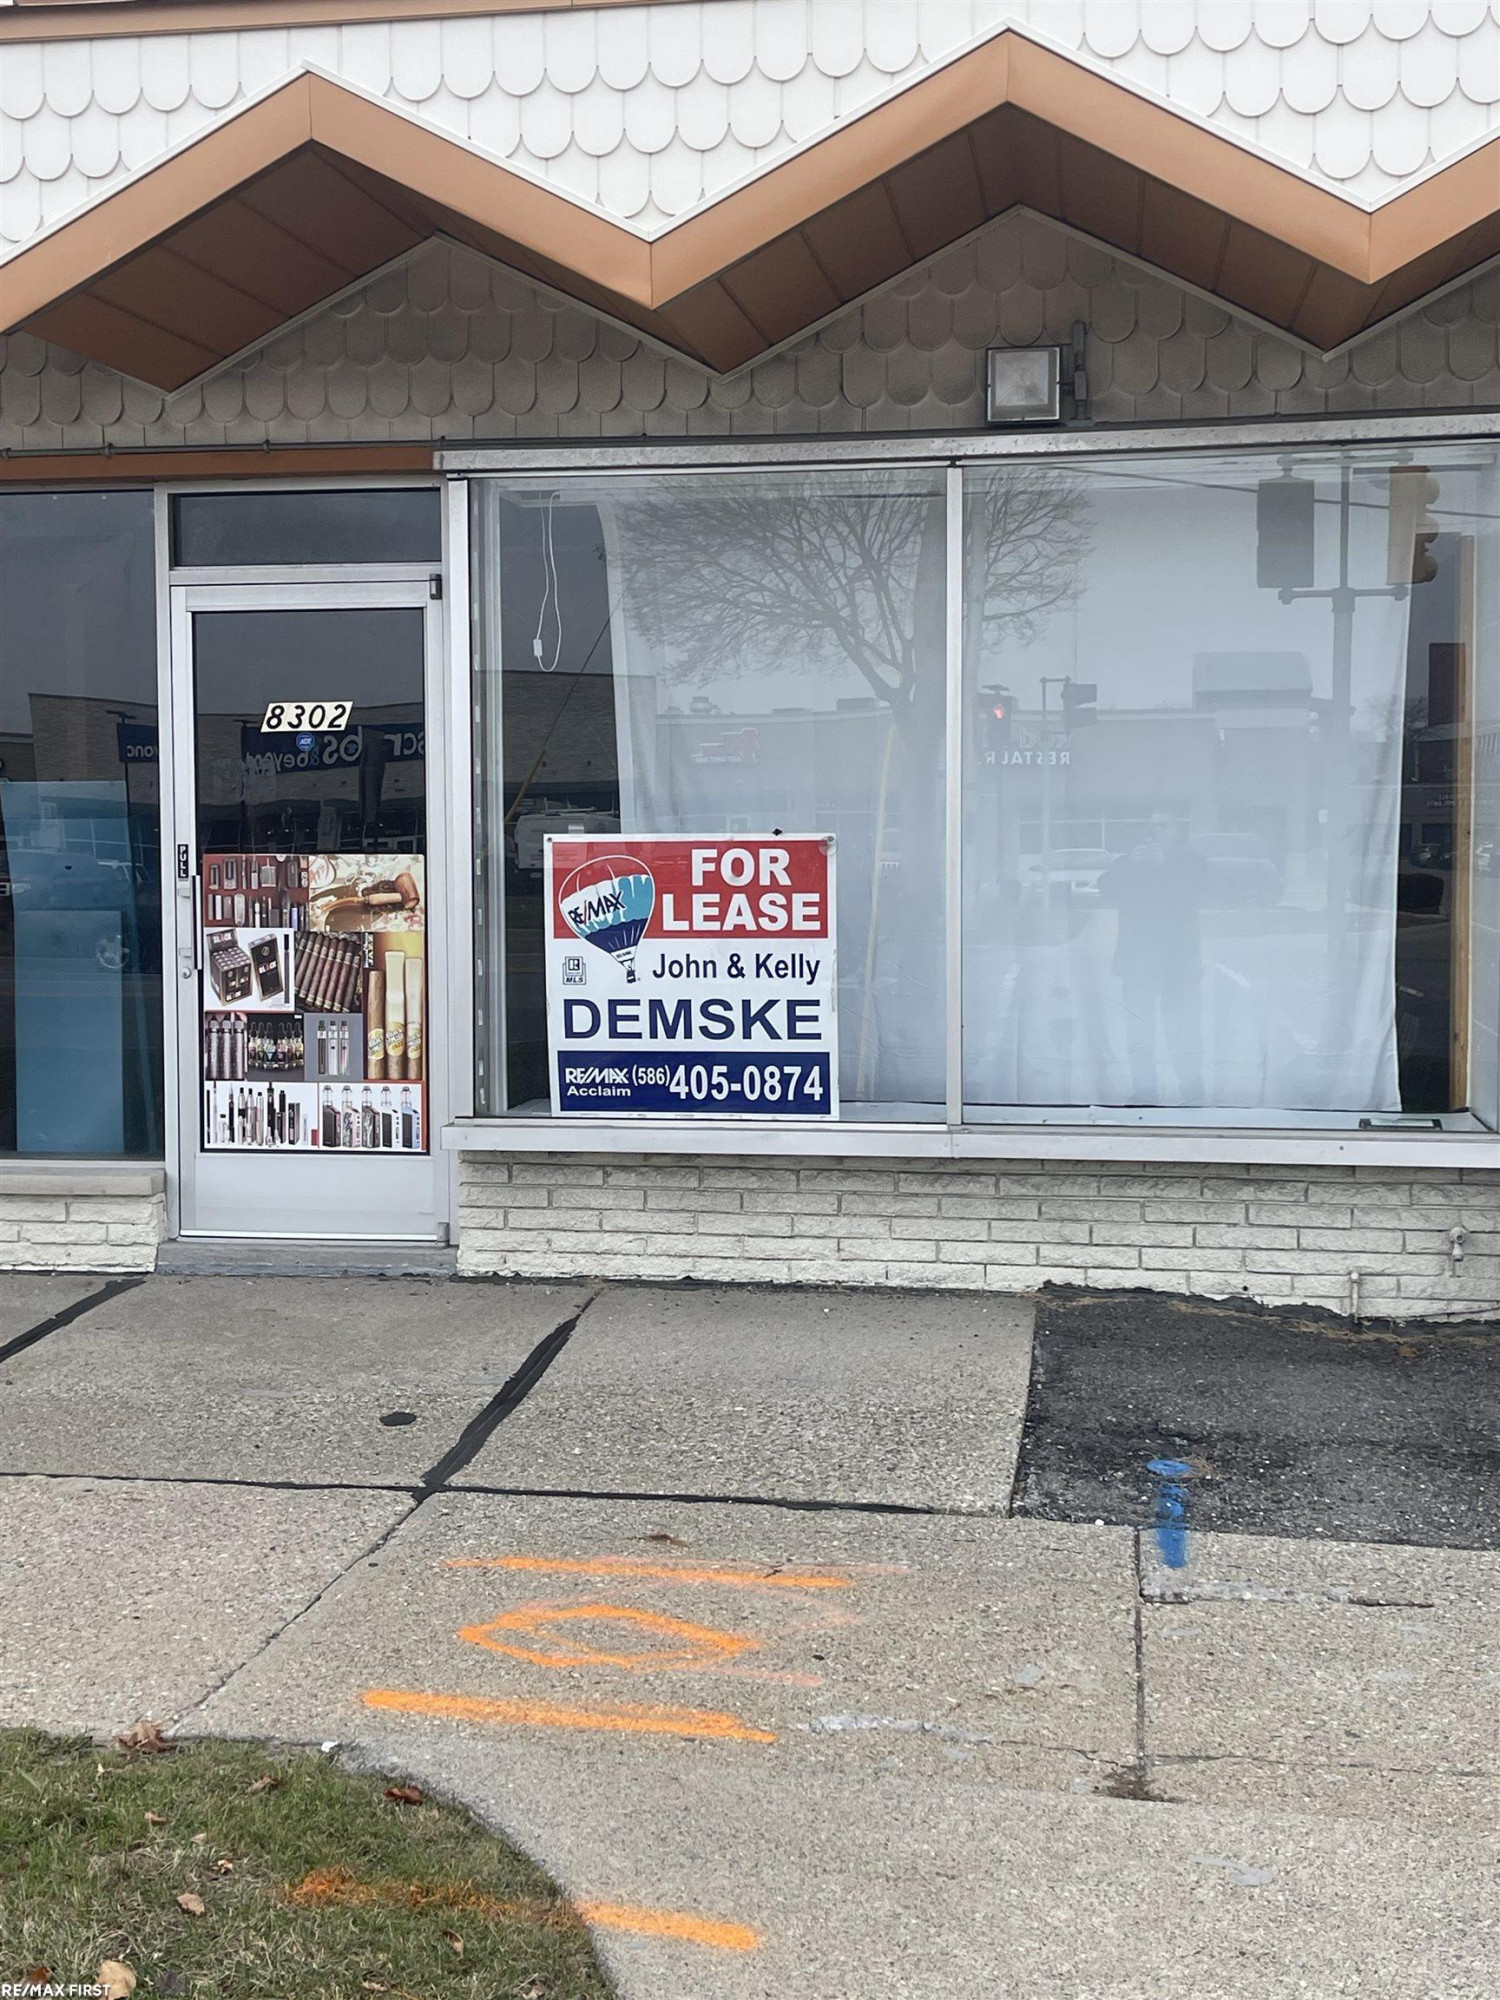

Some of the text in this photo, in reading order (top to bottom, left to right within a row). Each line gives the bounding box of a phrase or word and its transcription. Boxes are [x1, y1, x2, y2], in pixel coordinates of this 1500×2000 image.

[266, 703, 348, 729] 8302
[179, 846, 187, 877] PULL
[691, 848, 792, 887] FOR
[567, 890, 627, 927] RE/MAX
[662, 893, 821, 932] LEASE
[652, 953, 821, 985] John & Kelly
[563, 998, 822, 1041] DEMSKE
[565, 1067, 630, 1085] RE/MAX
[566, 1086, 631, 1097] Acclaim
[633, 1064, 823, 1102] (586) 405-0874
